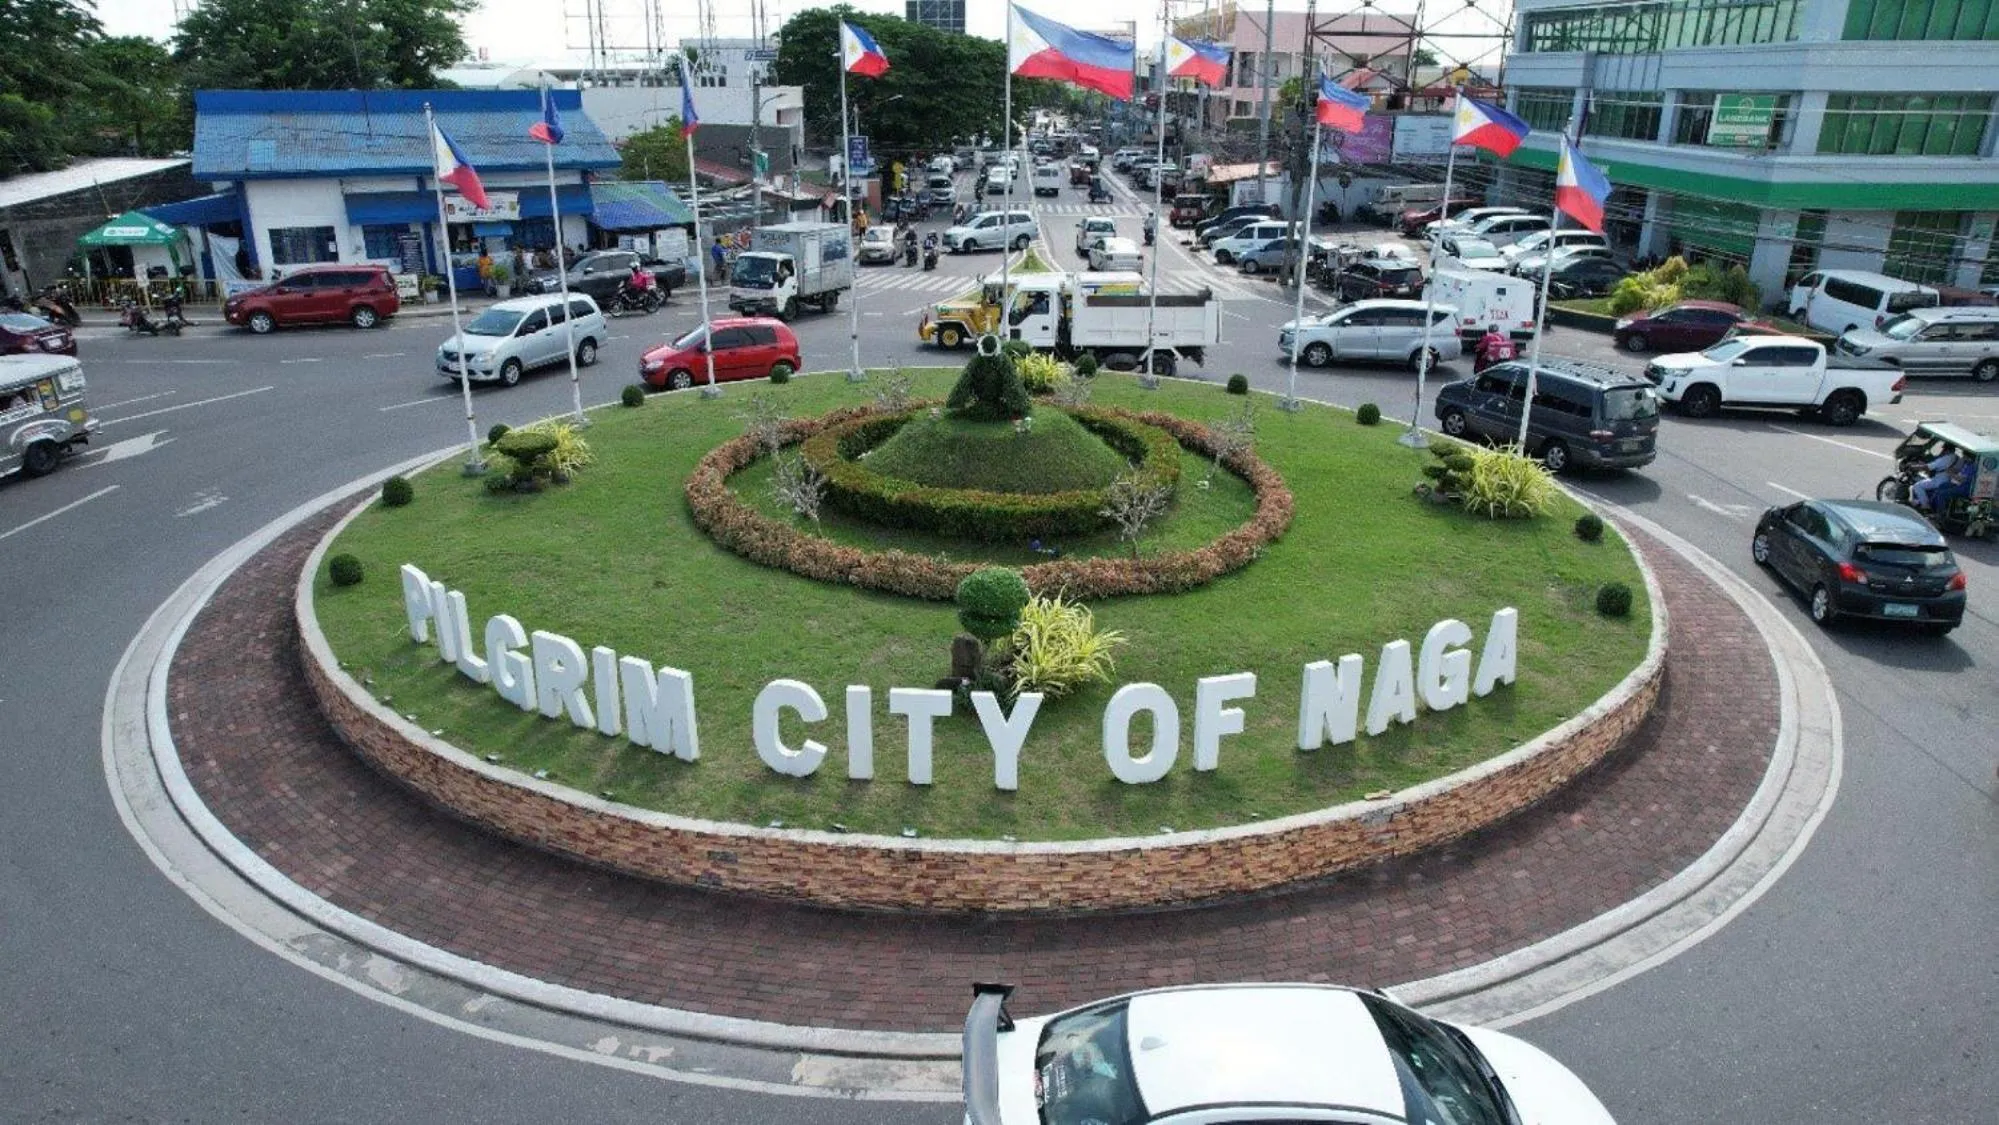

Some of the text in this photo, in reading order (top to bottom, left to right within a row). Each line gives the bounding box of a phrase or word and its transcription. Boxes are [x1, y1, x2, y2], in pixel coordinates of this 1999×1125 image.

[401, 564, 1520, 791] PILGRIM CITY OF NAGA
